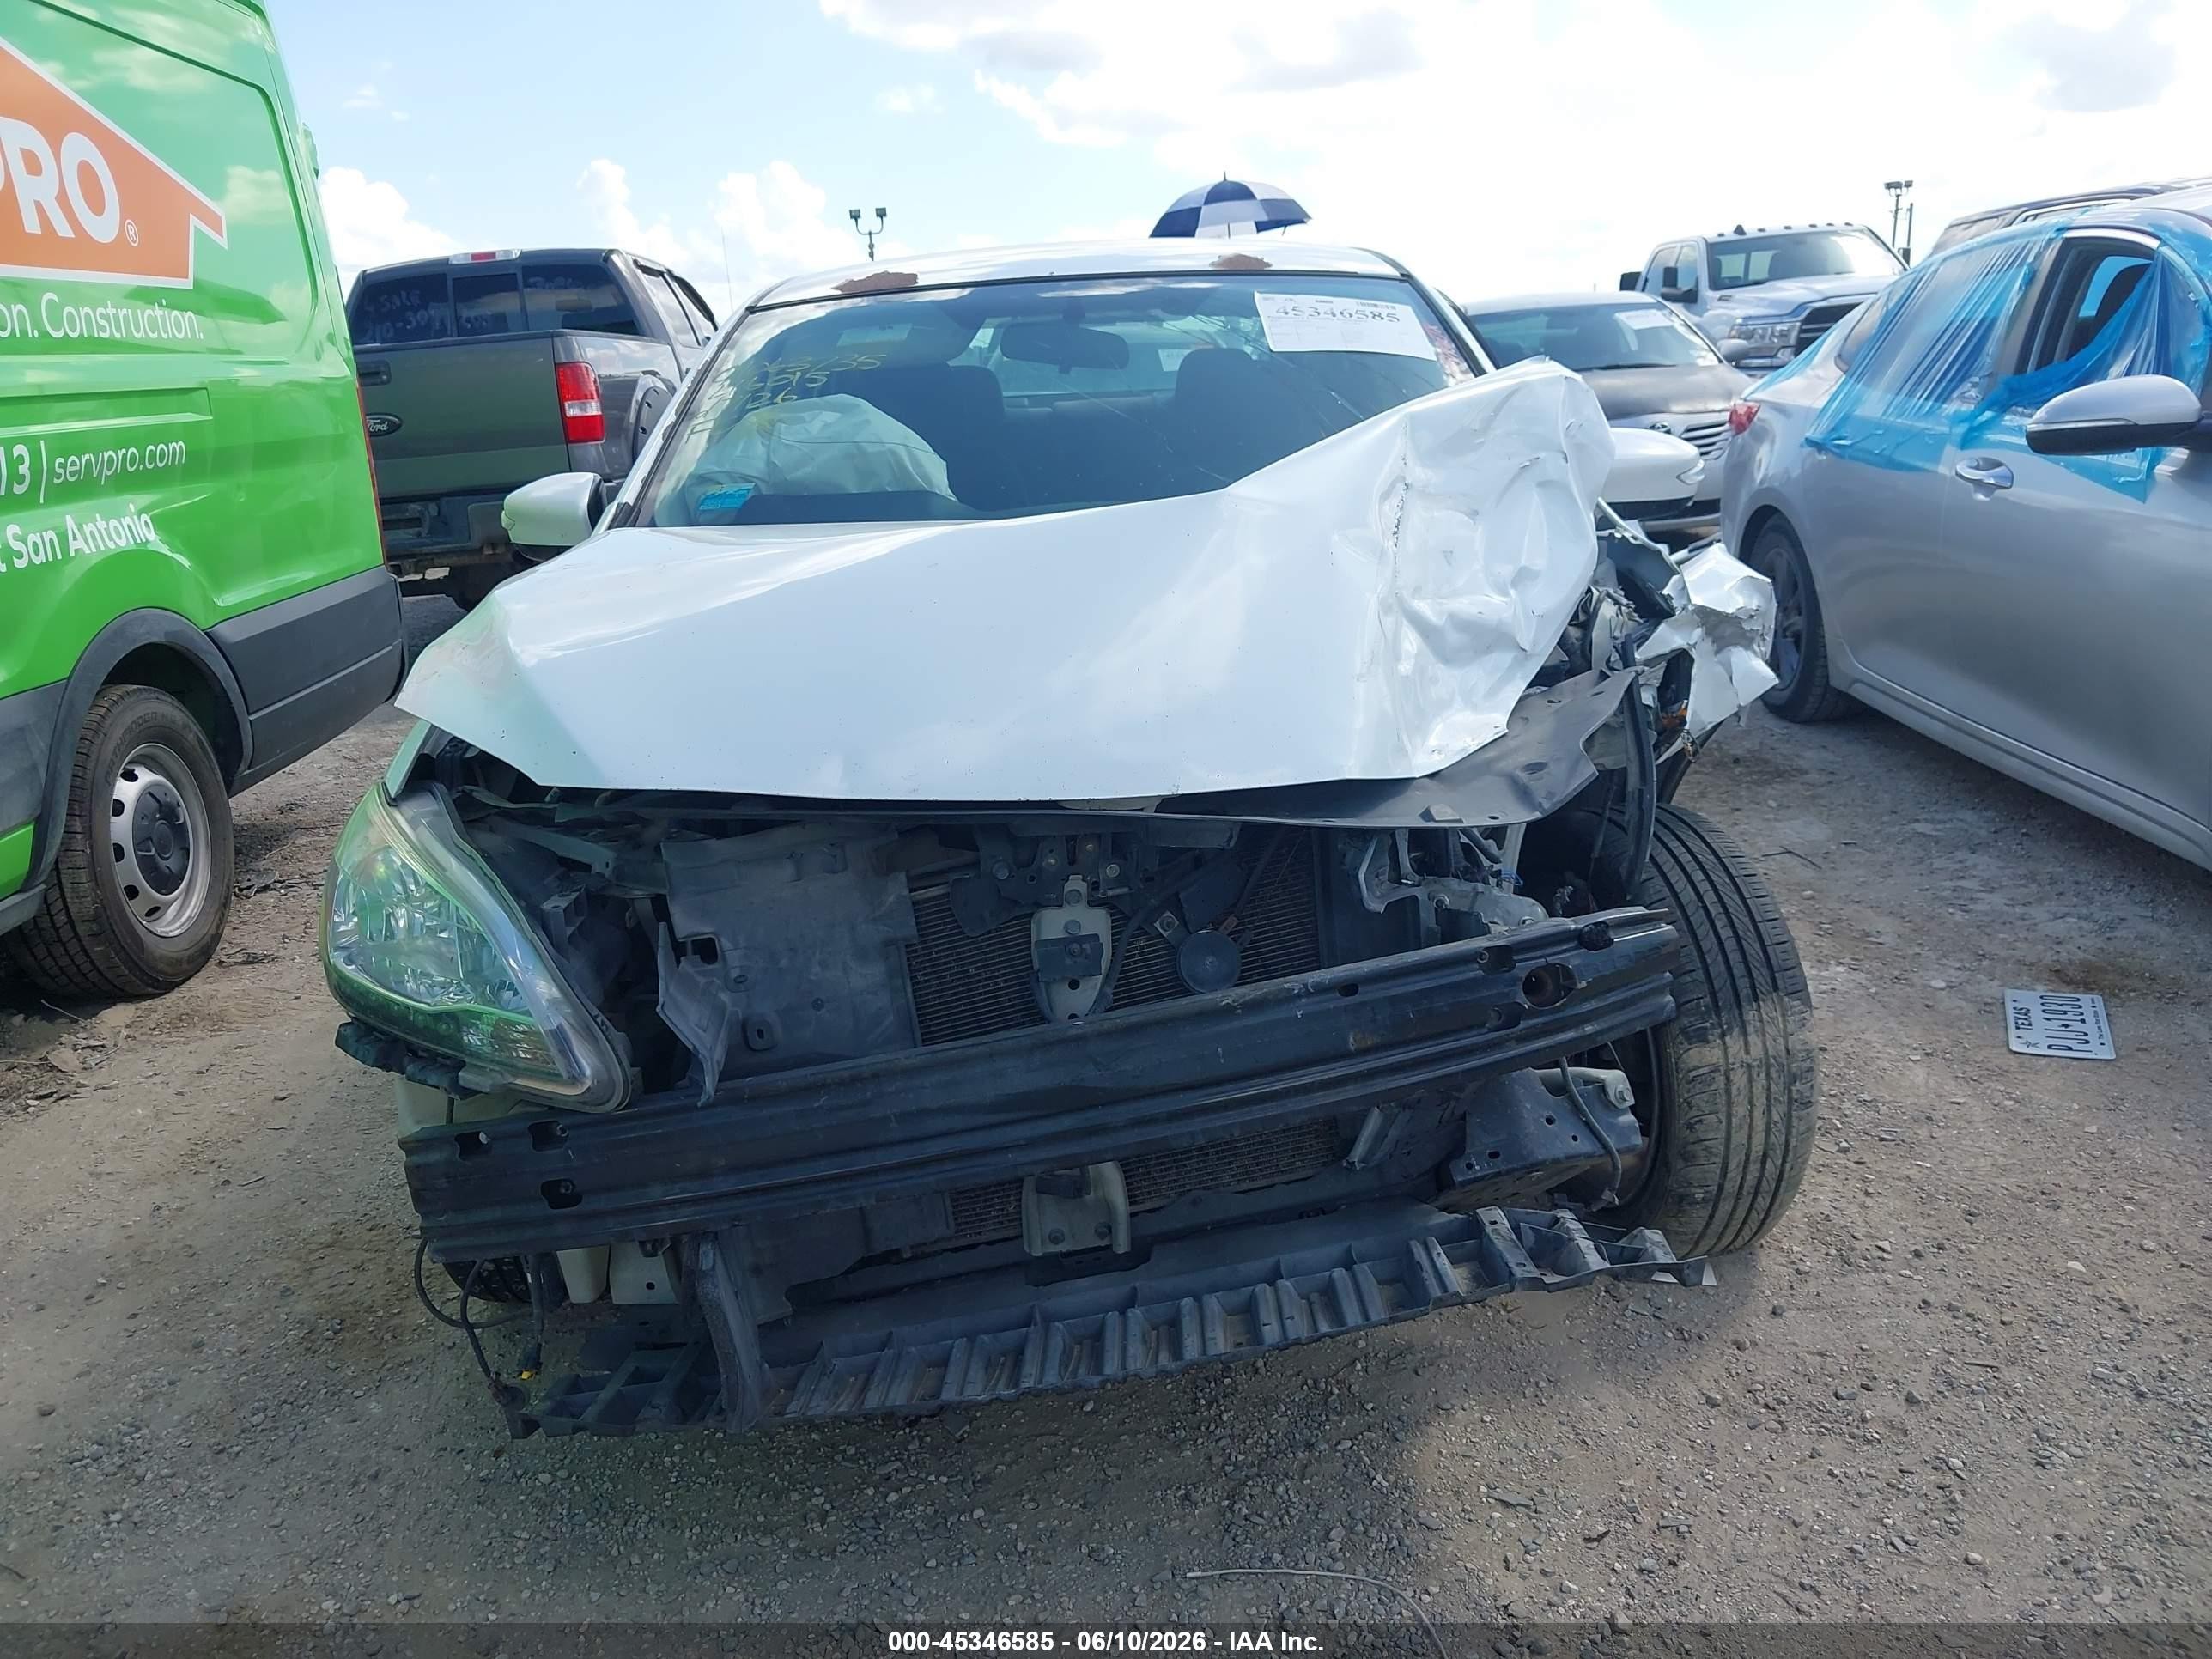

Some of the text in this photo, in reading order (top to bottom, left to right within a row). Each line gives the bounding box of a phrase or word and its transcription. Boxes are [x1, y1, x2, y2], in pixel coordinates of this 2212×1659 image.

[0, 116, 120, 244] RO
[40, 292, 204, 340] Construction.
[1275, 305, 1401, 324] 45346585
[52, 440, 187, 486] servpro.com
[6, 523, 63, 569] San
[64, 501, 157, 558] Antonio
[2012, 1006, 2033, 1031] TEXAS
